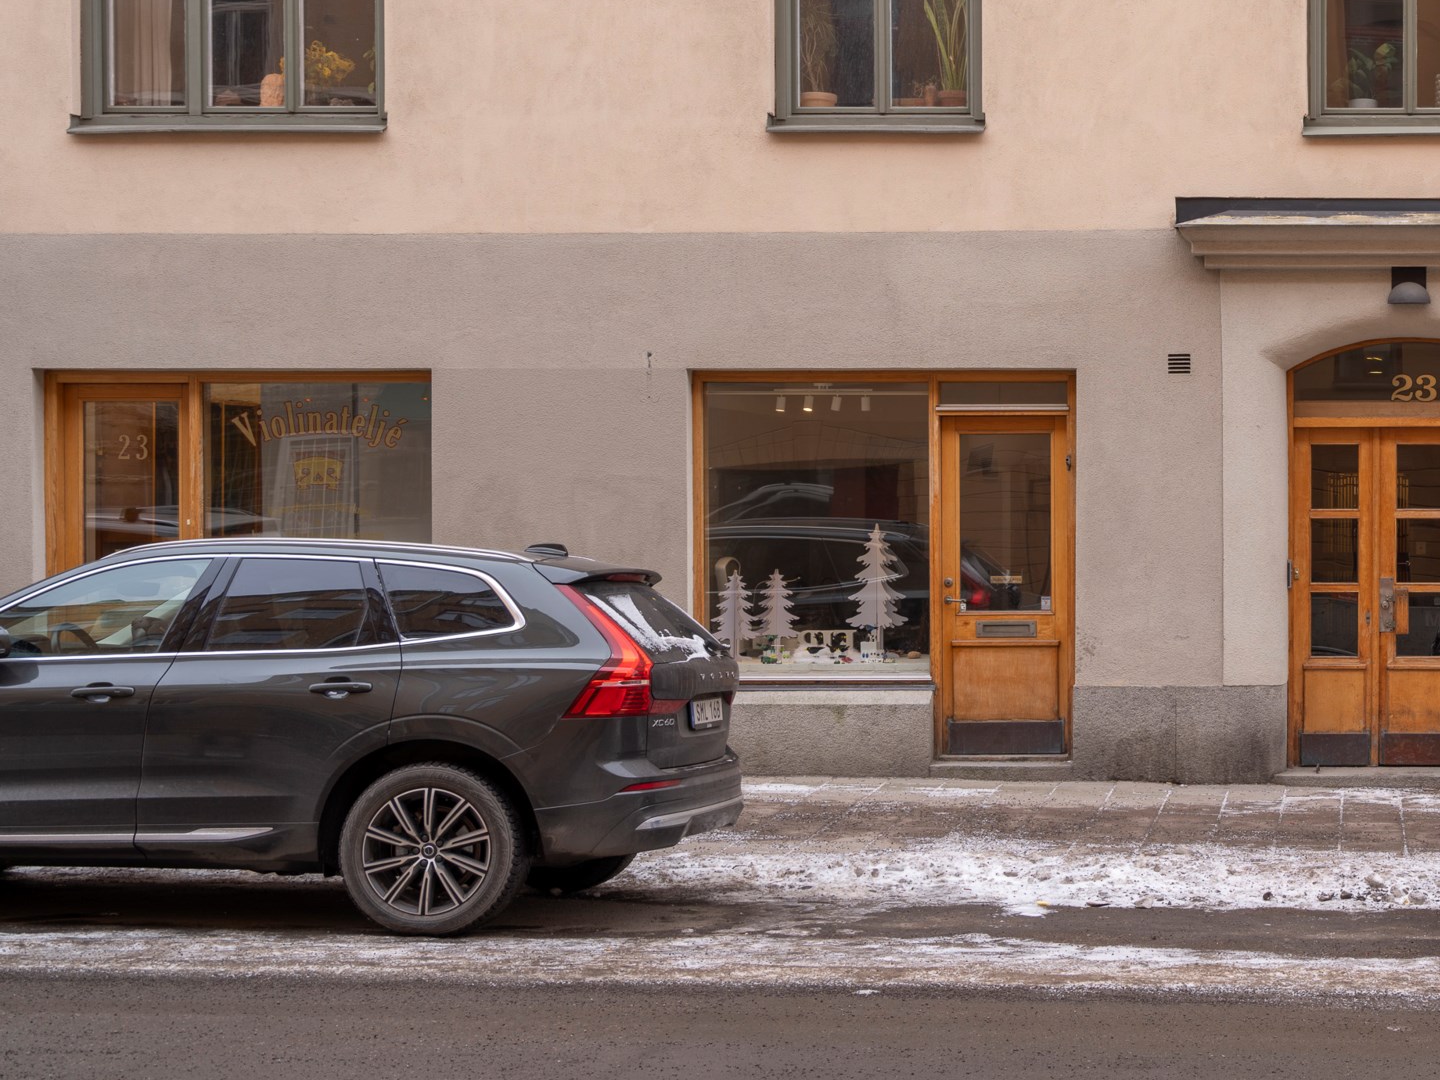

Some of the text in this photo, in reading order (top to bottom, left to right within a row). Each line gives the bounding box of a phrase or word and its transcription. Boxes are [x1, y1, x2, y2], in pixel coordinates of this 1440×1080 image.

[1391, 374, 1438, 402] 23
[231, 401, 409, 449] Violinateljé
[118, 434, 149, 460] 23
[652, 718, 675, 728] XC60
